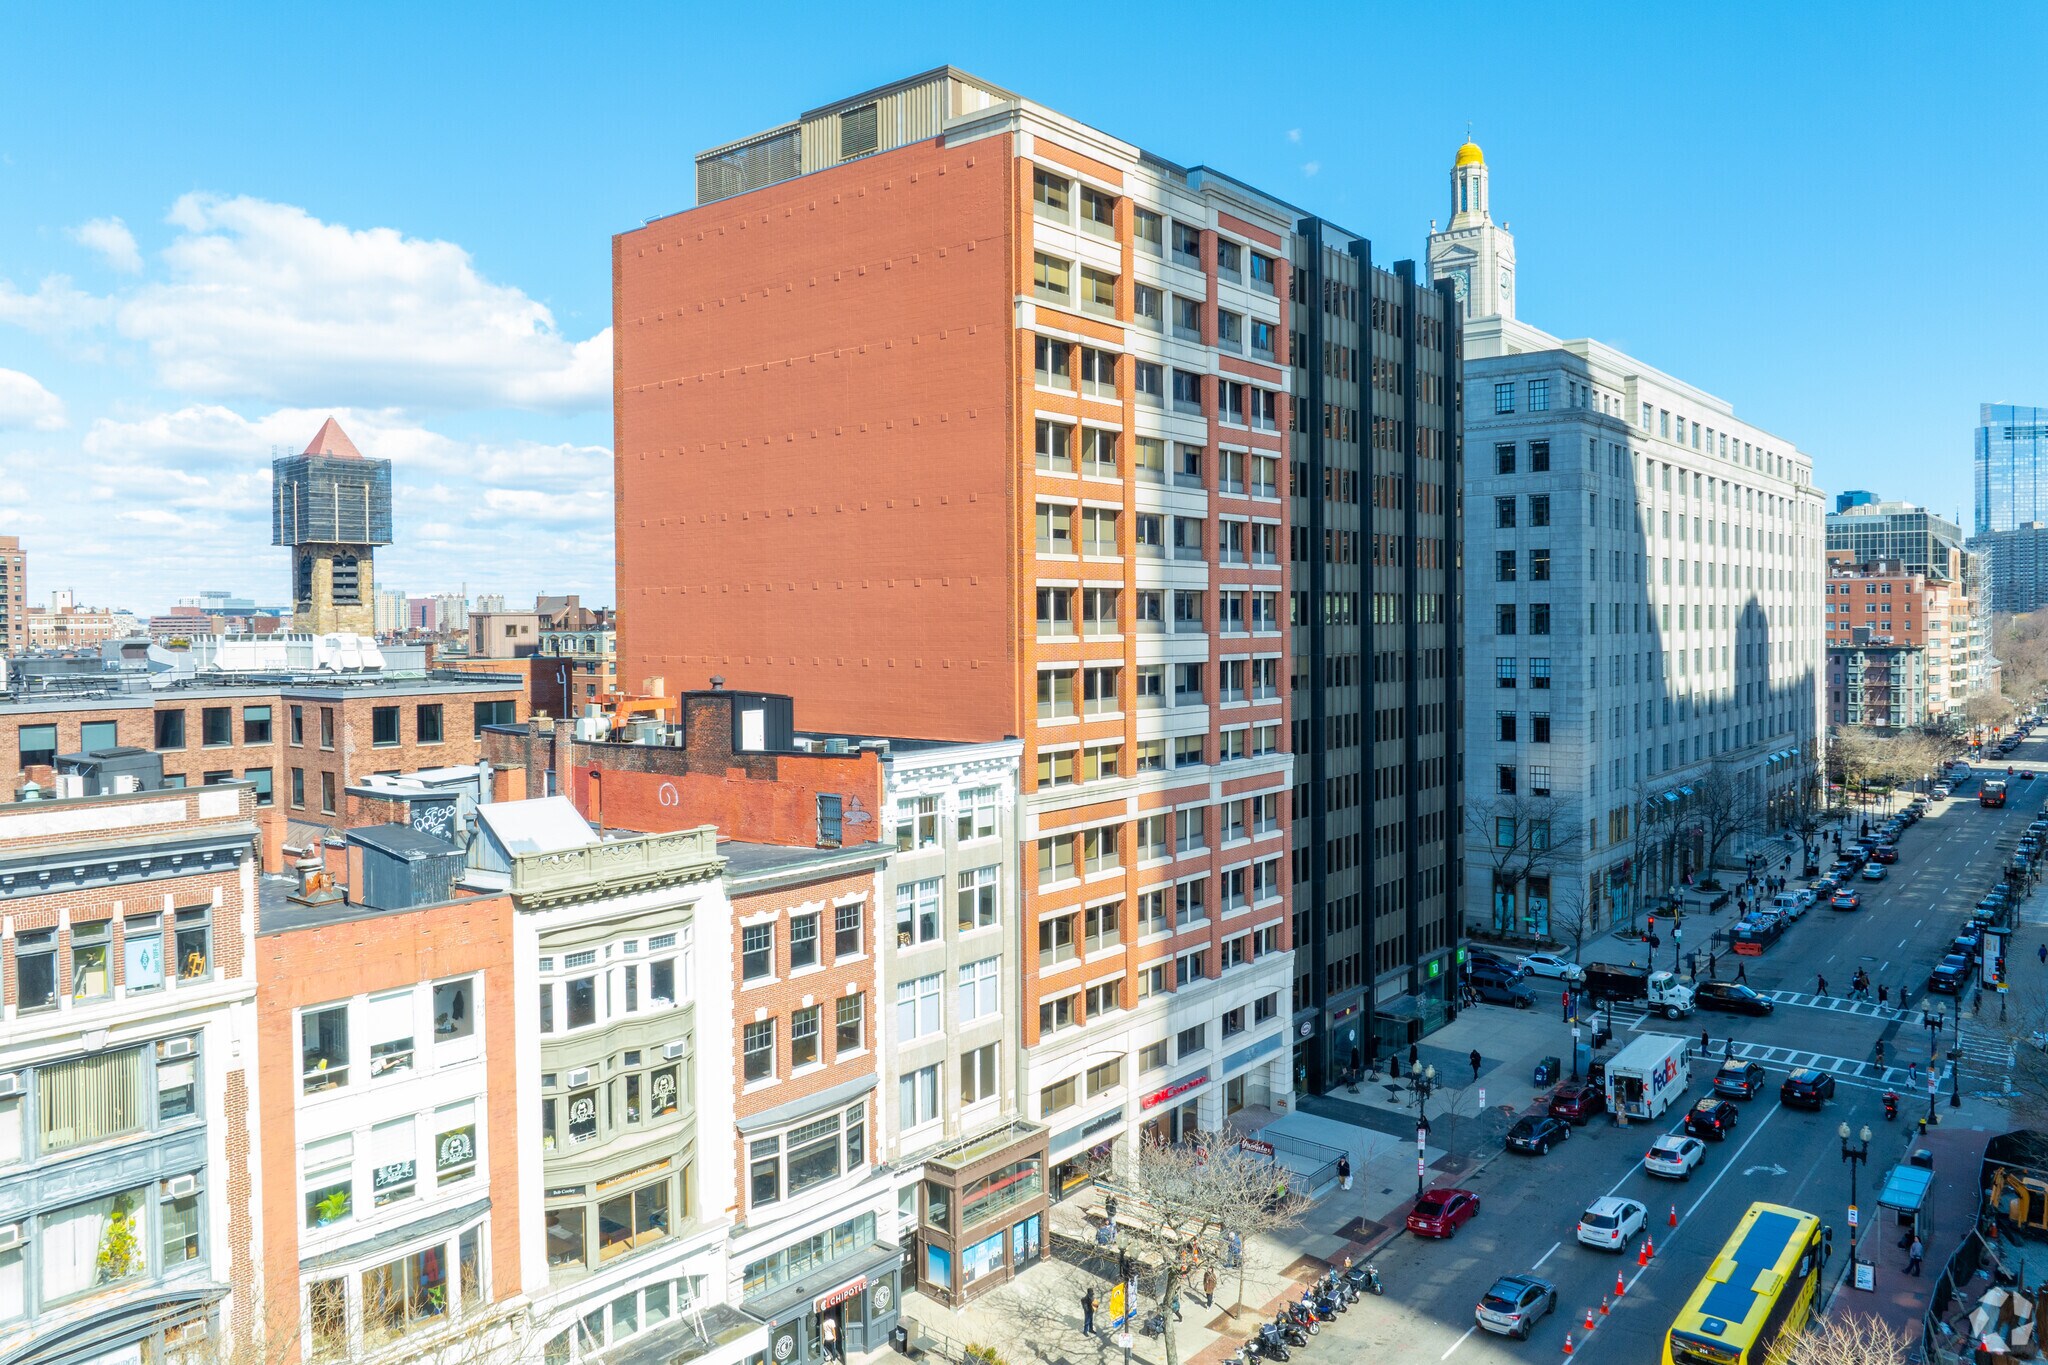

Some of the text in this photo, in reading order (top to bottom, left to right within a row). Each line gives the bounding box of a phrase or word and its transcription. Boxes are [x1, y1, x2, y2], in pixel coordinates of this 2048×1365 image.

[1653, 1055, 1678, 1095] FedEx
[1142, 1087, 1175, 1109] GNC
[829, 1281, 867, 1306] CHIPOTLE
